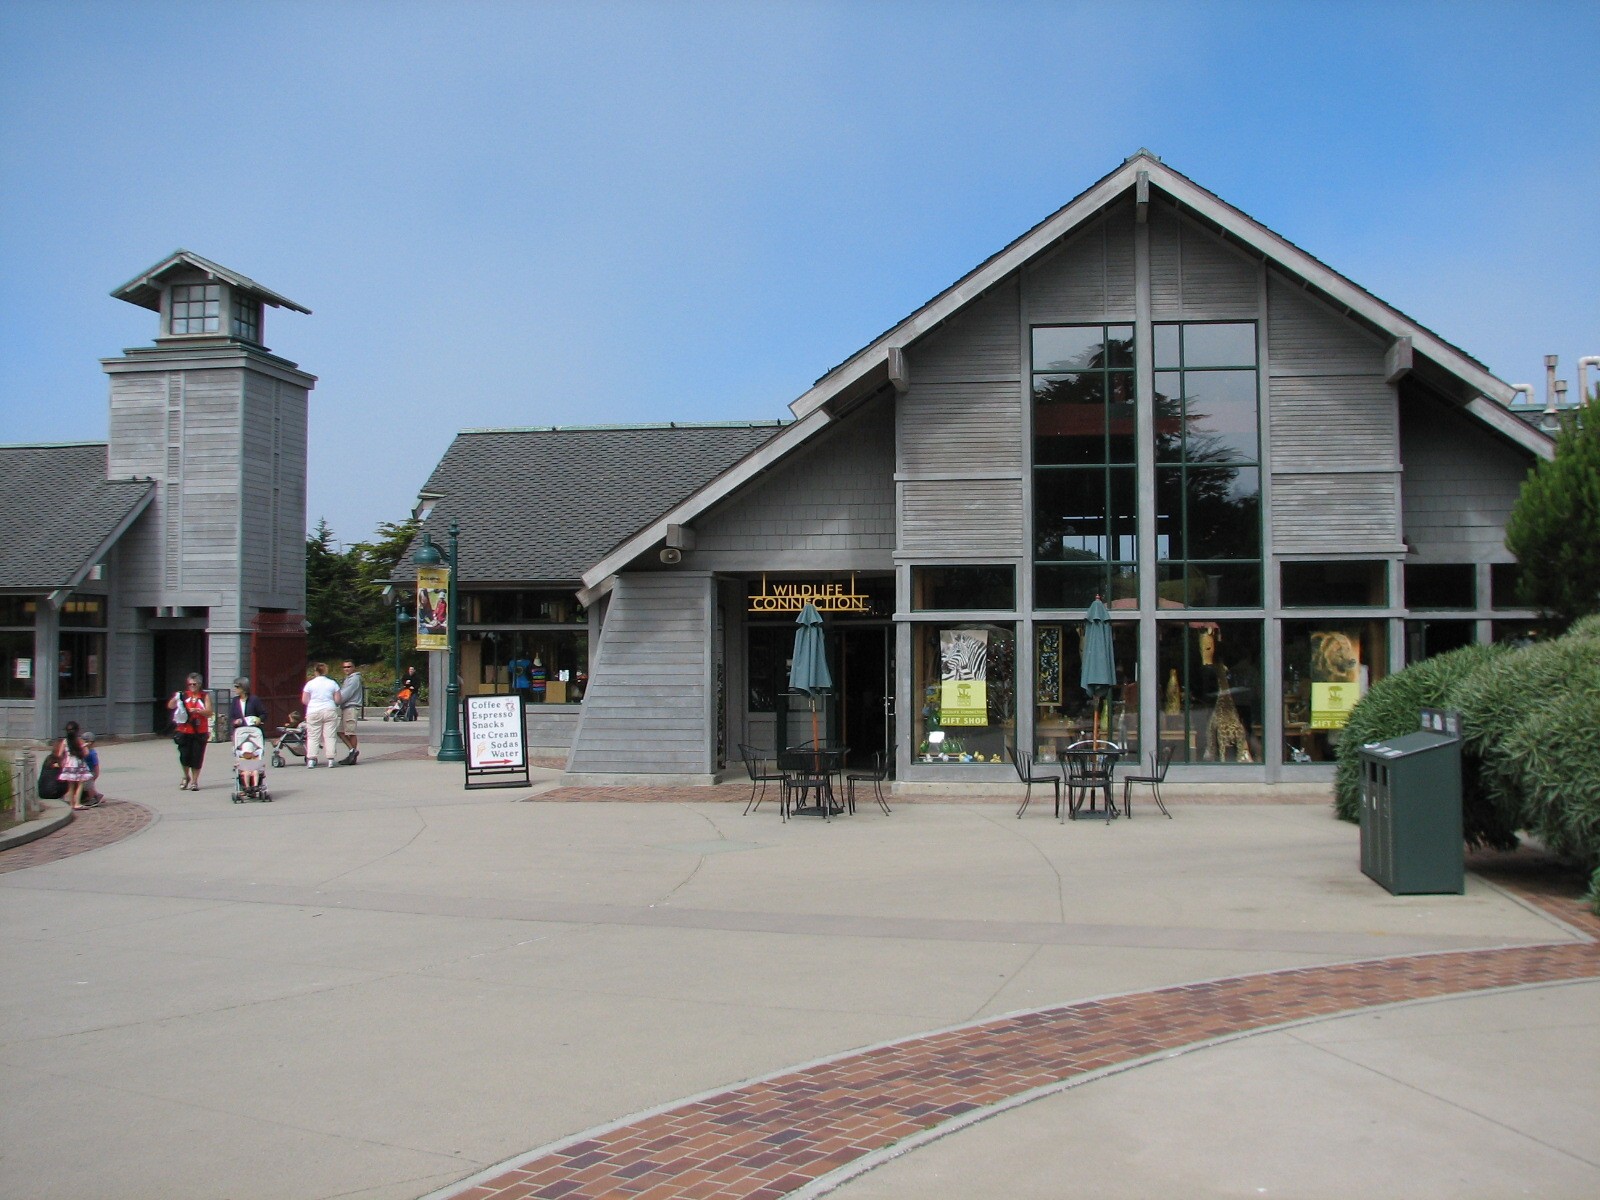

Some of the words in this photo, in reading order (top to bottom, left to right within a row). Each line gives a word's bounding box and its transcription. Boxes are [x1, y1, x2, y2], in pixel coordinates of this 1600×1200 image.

[773, 584, 843, 596] WILDLIFE
[471, 701, 501, 709] Coffee
[472, 711, 513, 720] Espresso
[472, 721, 505, 729] Snacks
[941, 717, 961, 725] GIFT
[964, 717, 987, 725] SHOP
[488, 731, 518, 739] Cream
[491, 741, 519, 749] Sodas
